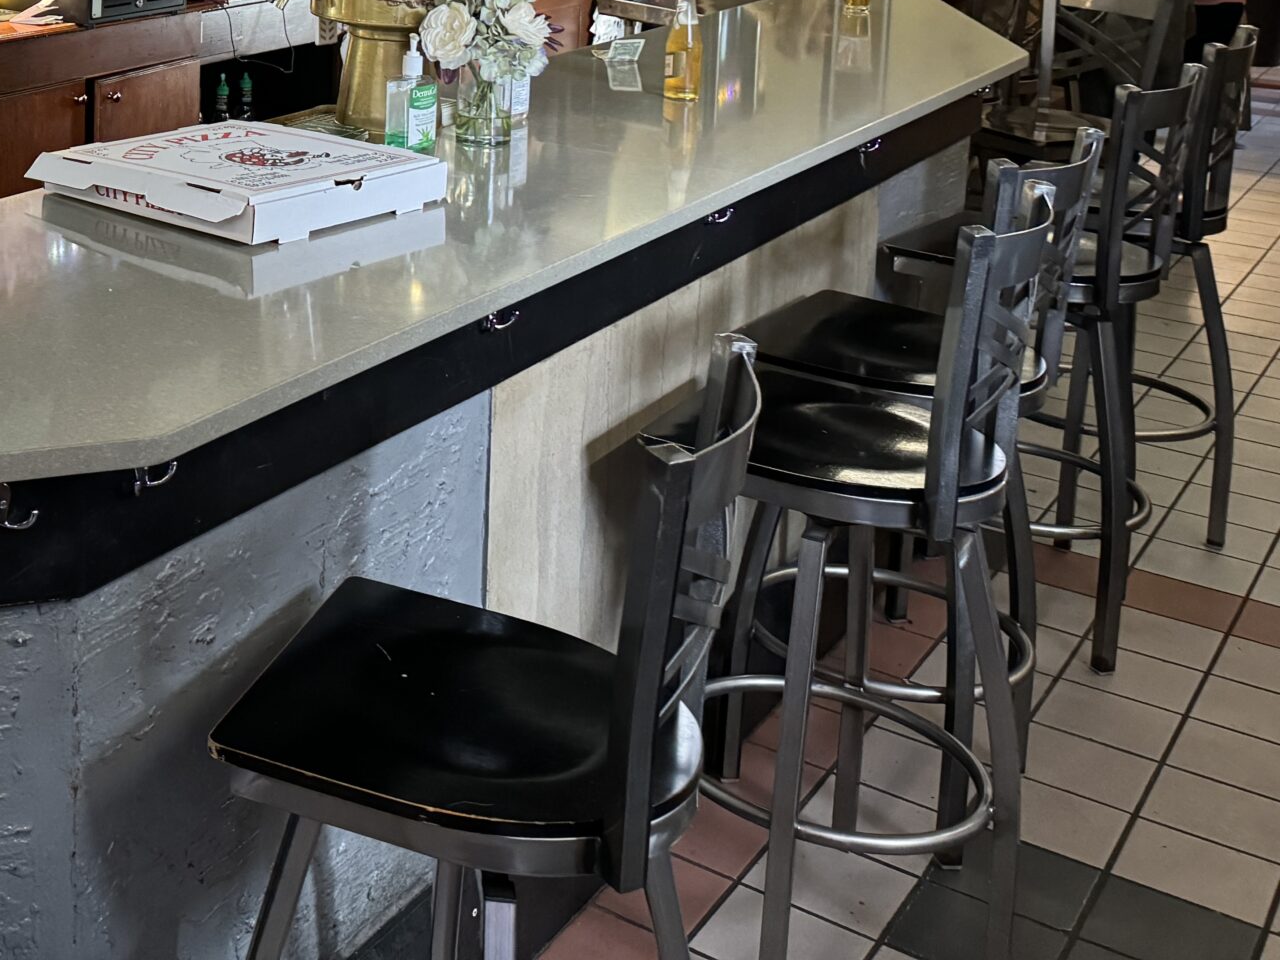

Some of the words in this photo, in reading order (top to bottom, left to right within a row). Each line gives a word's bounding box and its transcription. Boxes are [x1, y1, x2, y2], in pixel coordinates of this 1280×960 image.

[122, 143, 168, 160] CITY
[167, 130, 267, 147] PIZZA
[95, 185, 129, 203] CITY
